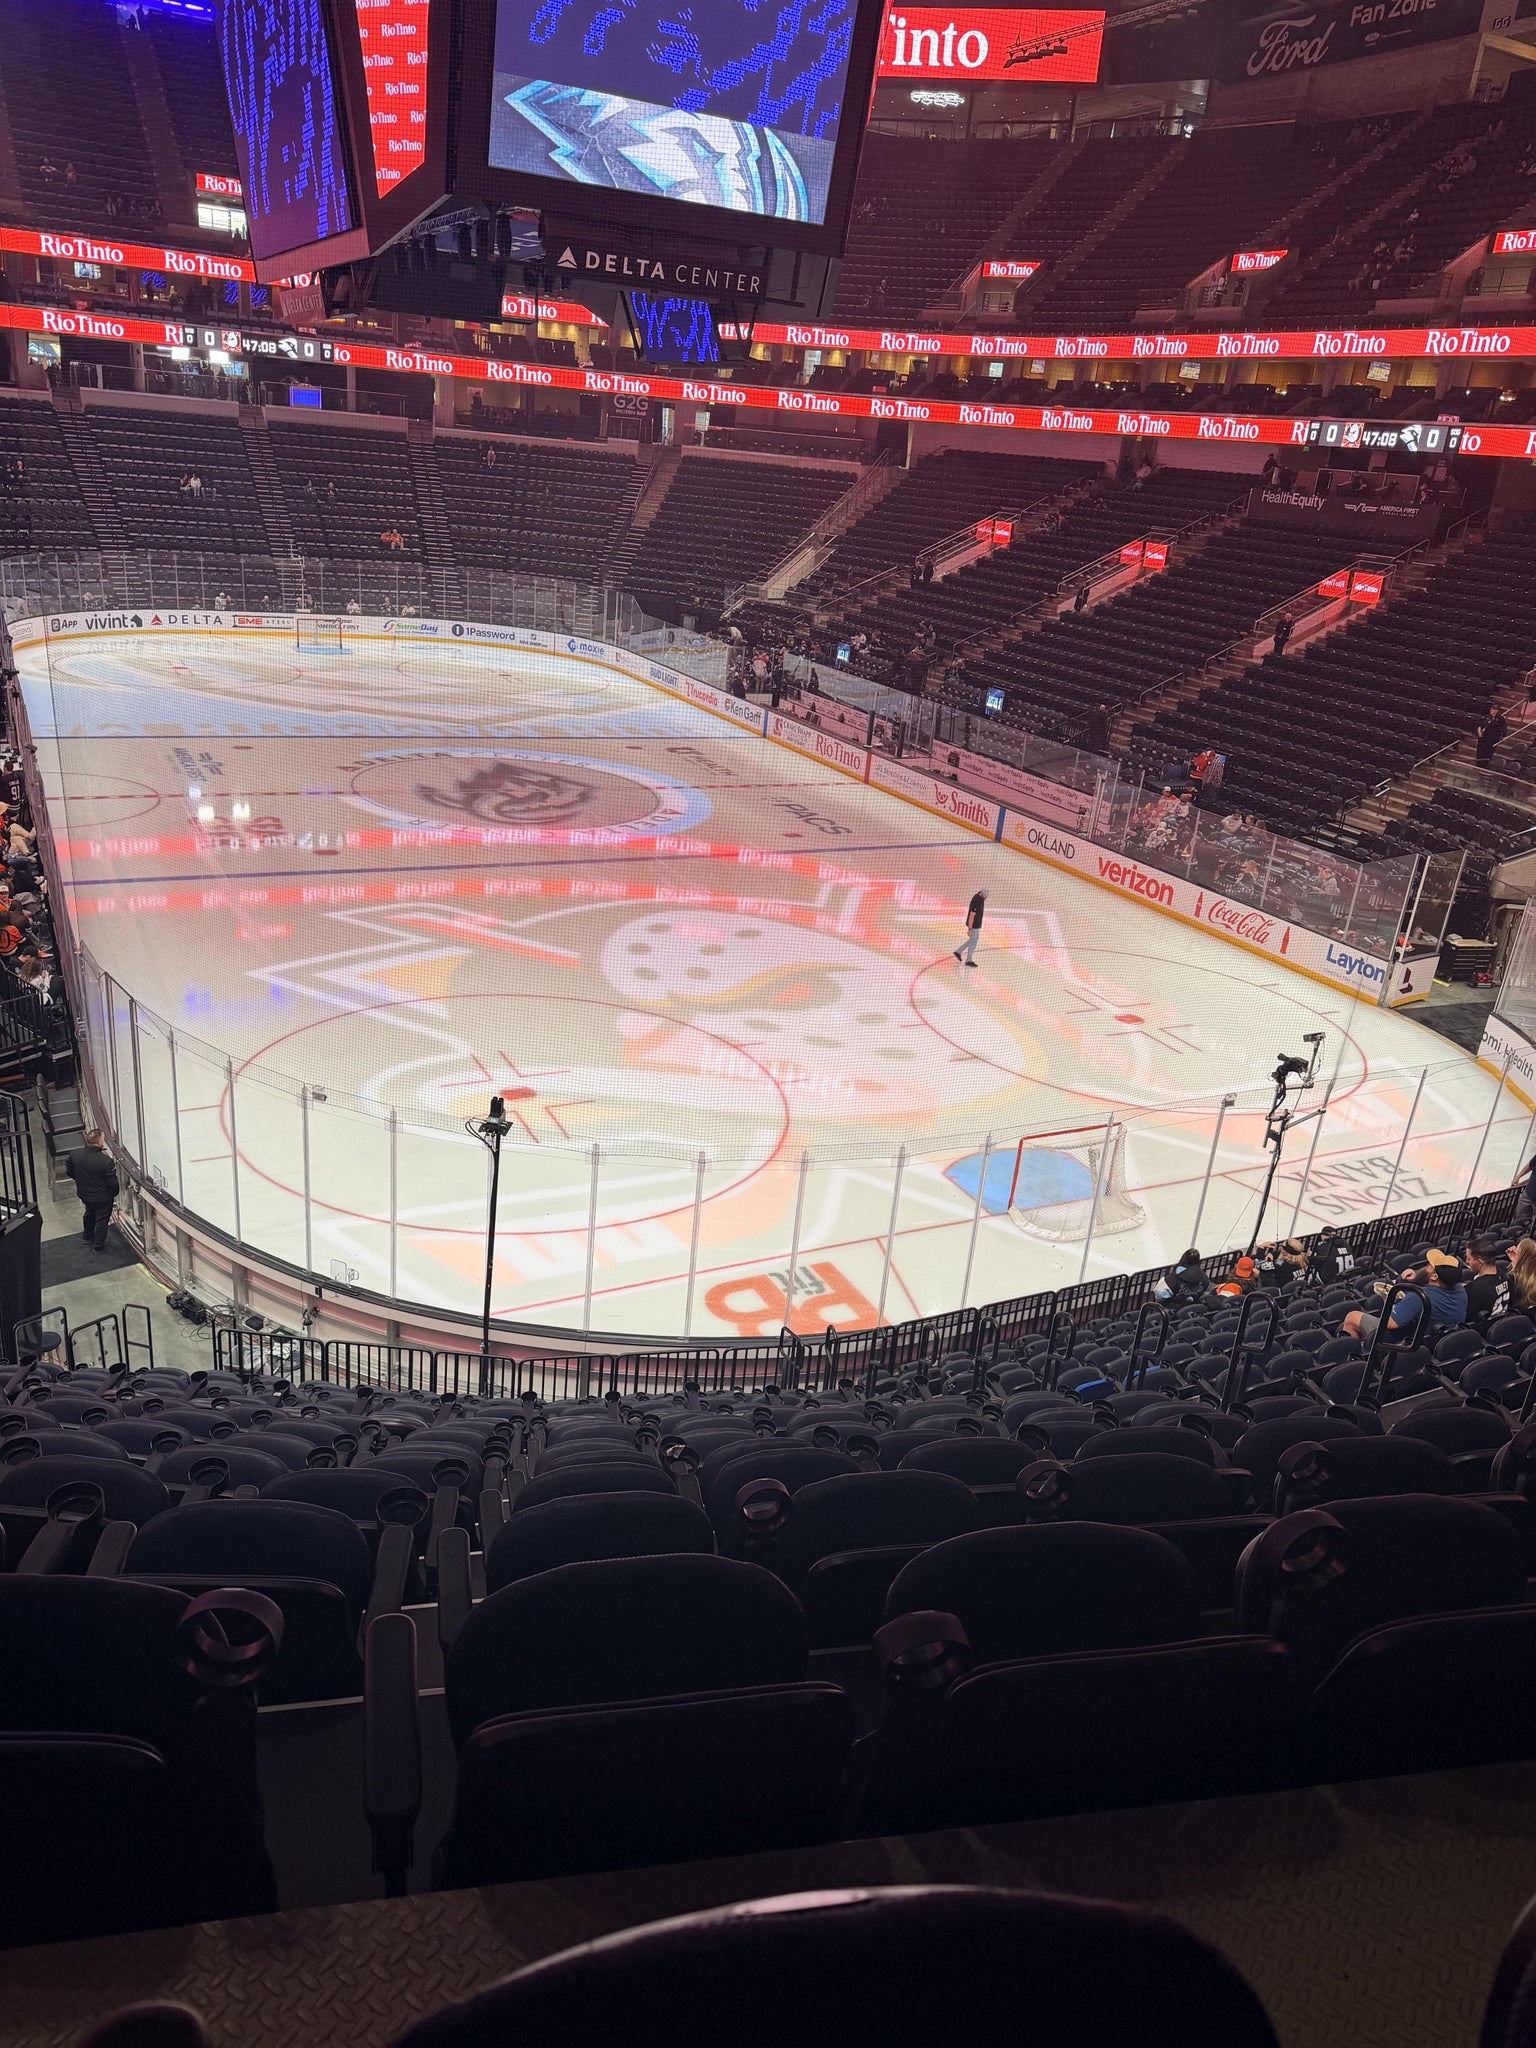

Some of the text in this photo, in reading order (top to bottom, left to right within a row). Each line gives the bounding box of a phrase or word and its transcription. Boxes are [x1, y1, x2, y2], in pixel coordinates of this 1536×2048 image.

[1350, 3, 1386, 27] Fan
[381, 23, 417, 38] RioTinto
[880, 14, 989, 68] into
[1247, 14, 1336, 76] Ford
[407, 51, 428, 65] RioT
[384, 81, 420, 96] RioTinto
[370, 111, 397, 125] ioTinto
[388, 138, 423, 153] RioTinto
[376, 167, 401, 180] oTinto
[205, 175, 242, 194] RioTi
[1501, 230, 1536, 251] RioT
[40, 235, 242, 279] RioTinto RioTinto
[585, 250, 761, 295] DELTA CENTER
[989, 262, 1033, 278] RioTinto
[502, 297, 557, 319] ioTinto
[42, 311, 125, 338] RioTinto
[204, 331, 215, 346] 0
[242, 338, 277, 354] 47:08
[786, 326, 1511, 356] RioTinto RioTinto RioTinto RioTinto RioTinto RioTinto RioTinto RioTinto
[304, 342, 315, 358] 0
[386, 350, 1260, 440] RioTinto RioTinto RioTinto RioTinto RioTinto RioTinto RioTinto RioTinto RioTinto RioTinto
[613, 394, 649, 411] G2G
[1326, 425, 1338, 443] 0
[1362, 431, 1397, 448] 47:08
[1426, 428, 1440, 448] 0
[1261, 490, 1325, 511] HealthEquity
[85, 613, 129, 631] vivint
[168, 614, 223, 626] DELTA
[466, 626, 515, 641] 1Password
[815, 733, 861, 770] RioTinto
[949, 790, 990, 827] Smith's
[1028, 828, 1076, 860] OKLAND
[1098, 856, 1174, 906] verizon
[1325, 943, 1386, 984] Layton
[1274, 1156, 1450, 1216] ZIONS BANK
